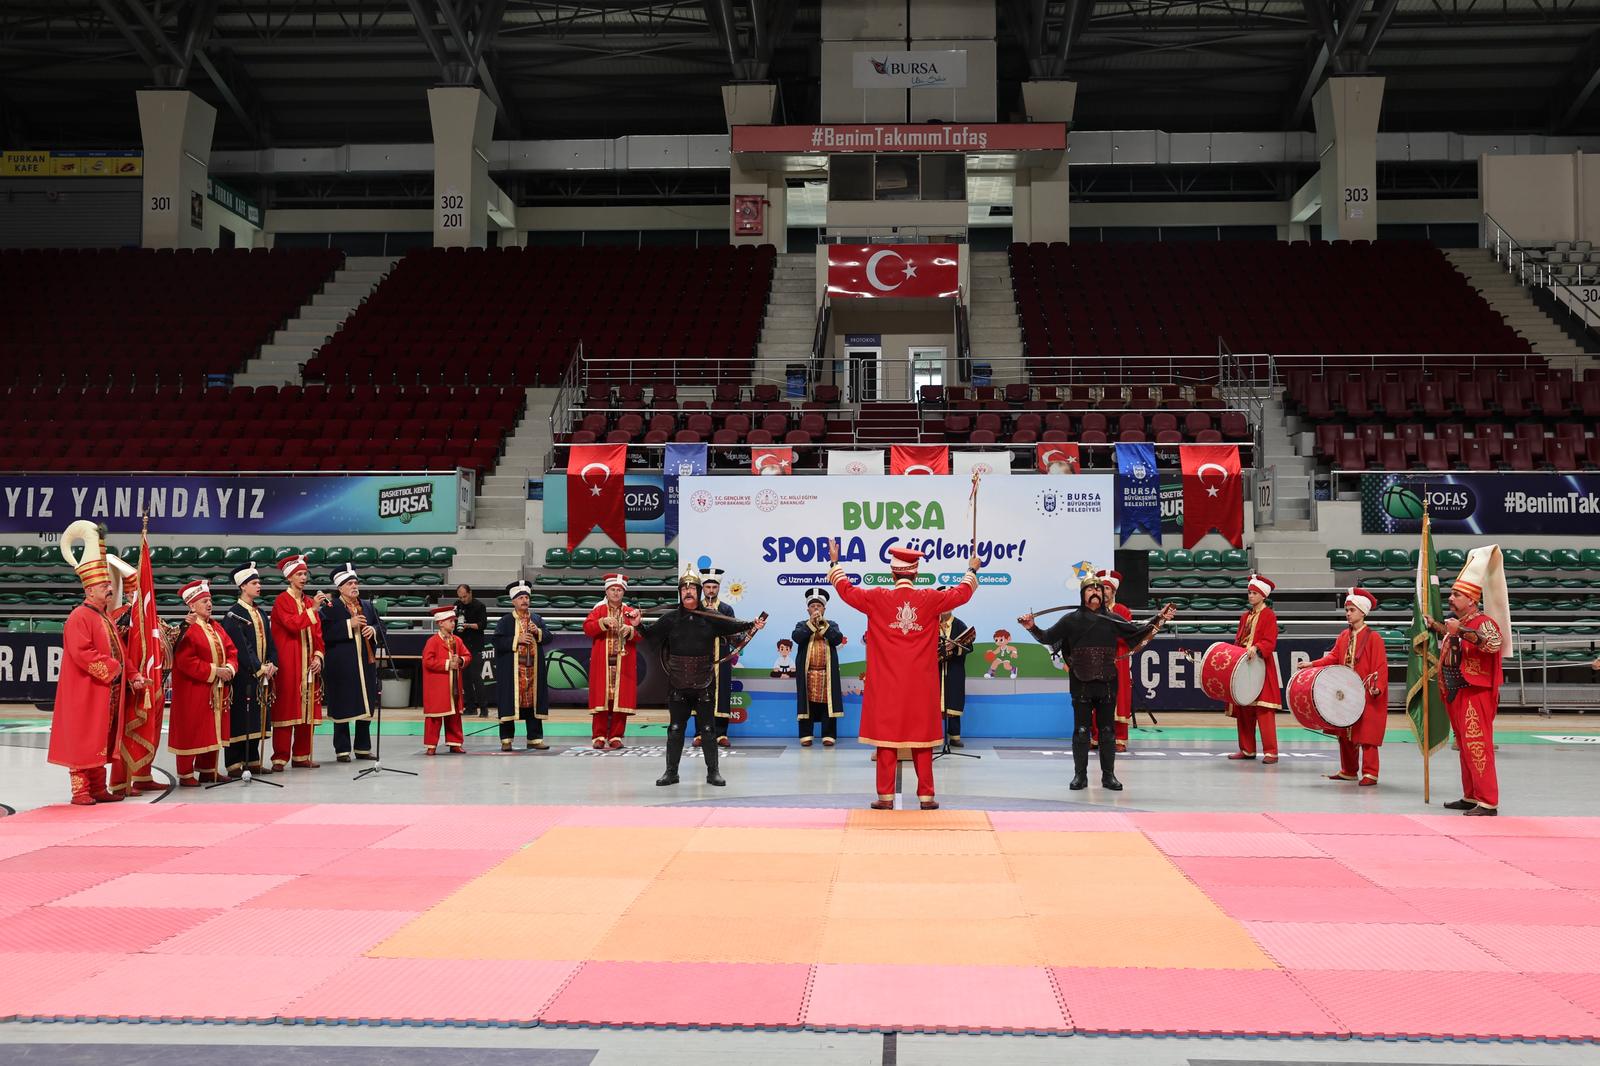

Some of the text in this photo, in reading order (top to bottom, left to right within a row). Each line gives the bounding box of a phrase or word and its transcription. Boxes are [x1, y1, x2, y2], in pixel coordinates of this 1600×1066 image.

[892, 63, 938, 74] BURSA
[8, 155, 45, 163] FURKAN
[15, 164, 38, 172] KAFE
[1344, 188, 1368, 202] 303
[152, 196, 170, 210] 301
[441, 196, 464, 209] 302
[443, 214, 462, 228] 201
[1583, 289, 1600, 302] 30
[381, 484, 430, 498] BASKETBOL KENTİ
[1259, 486, 1270, 507] 102
[4, 487, 265, 518] YIZ YANINDAYIZ
[380, 494, 429, 516] BURSA
[624, 493, 660, 510] OFAŞ
[1426, 492, 1468, 509] TOFAŞ
[1504, 492, 1600, 513] #BenimTak
[842, 501, 945, 530] BURSA
[762, 536, 866, 562] SPORLA
